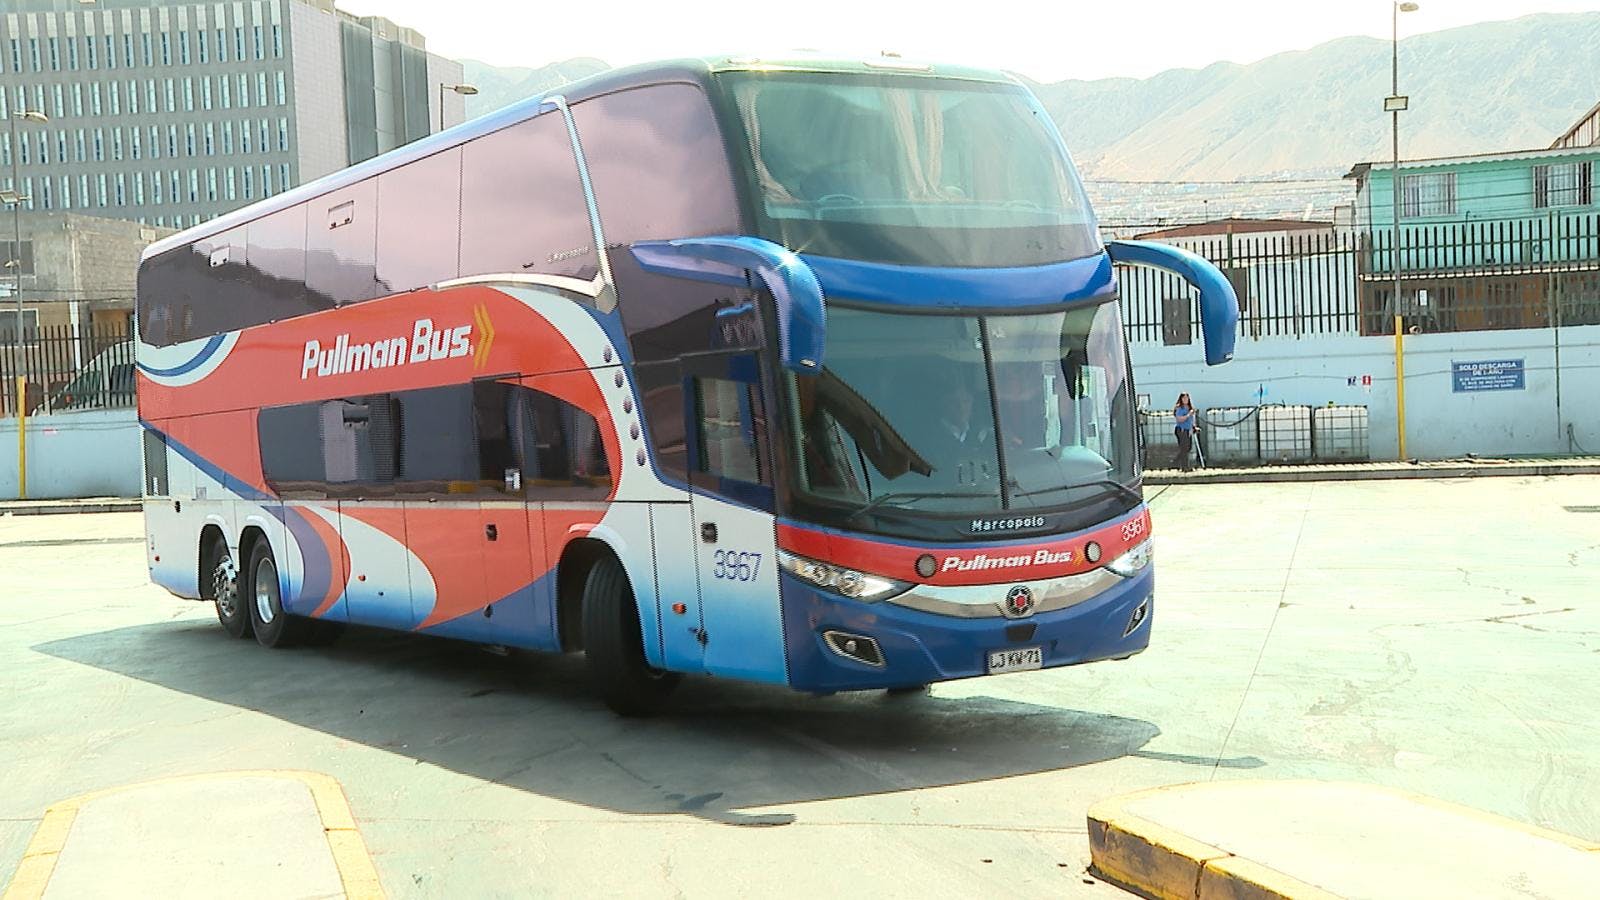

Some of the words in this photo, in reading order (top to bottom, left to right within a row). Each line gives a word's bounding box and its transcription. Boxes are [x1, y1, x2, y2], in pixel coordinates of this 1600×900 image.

[301, 333, 408, 380] Pullman
[1459, 363, 1478, 371] SOLO
[1479, 361, 1517, 370] DESCARGA
[971, 516, 1045, 531] Marcopolo
[1120, 517, 1145, 541] 3967
[713, 549, 762, 582] 3967
[941, 554, 1032, 572] Pullman
